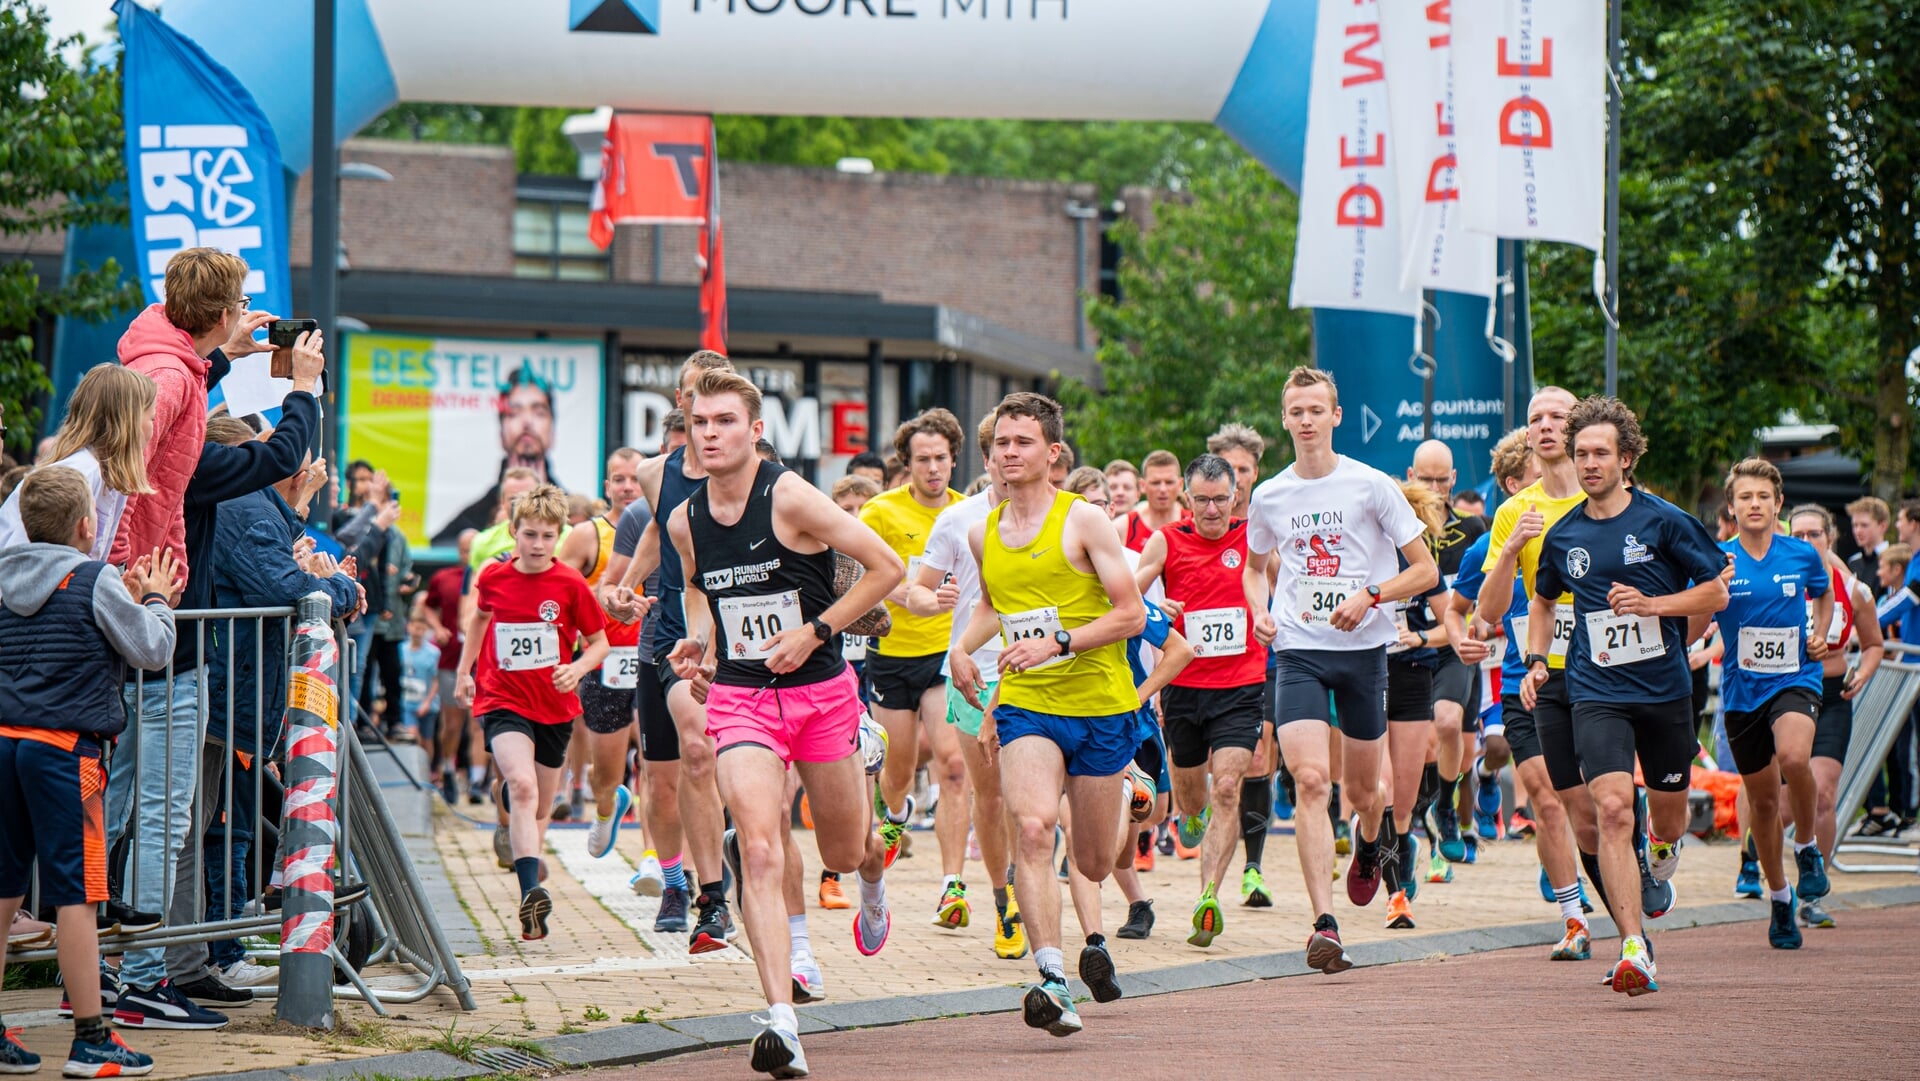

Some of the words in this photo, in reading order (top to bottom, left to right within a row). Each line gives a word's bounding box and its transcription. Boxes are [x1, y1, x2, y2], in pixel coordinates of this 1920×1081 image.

[370, 348, 513, 393] BESTEL
[518, 353, 577, 394] NU
[624, 362, 681, 388] RAB
[1396, 400, 1504, 419] Acountant
[734, 558, 781, 576] RUNNERS
[1316, 565, 1337, 575] City
[735, 572, 769, 585] WORLD
[741, 613, 782, 641] 410
[1202, 622, 1234, 643] 378
[1553, 618, 1574, 641] 05
[1605, 621, 1643, 649] 271
[511, 636, 543, 657] 291
[844, 632, 863, 648] 90
[1640, 643, 1663, 655] Bosch
[1753, 641, 1786, 660] 354
[619, 658, 639, 676] 25
